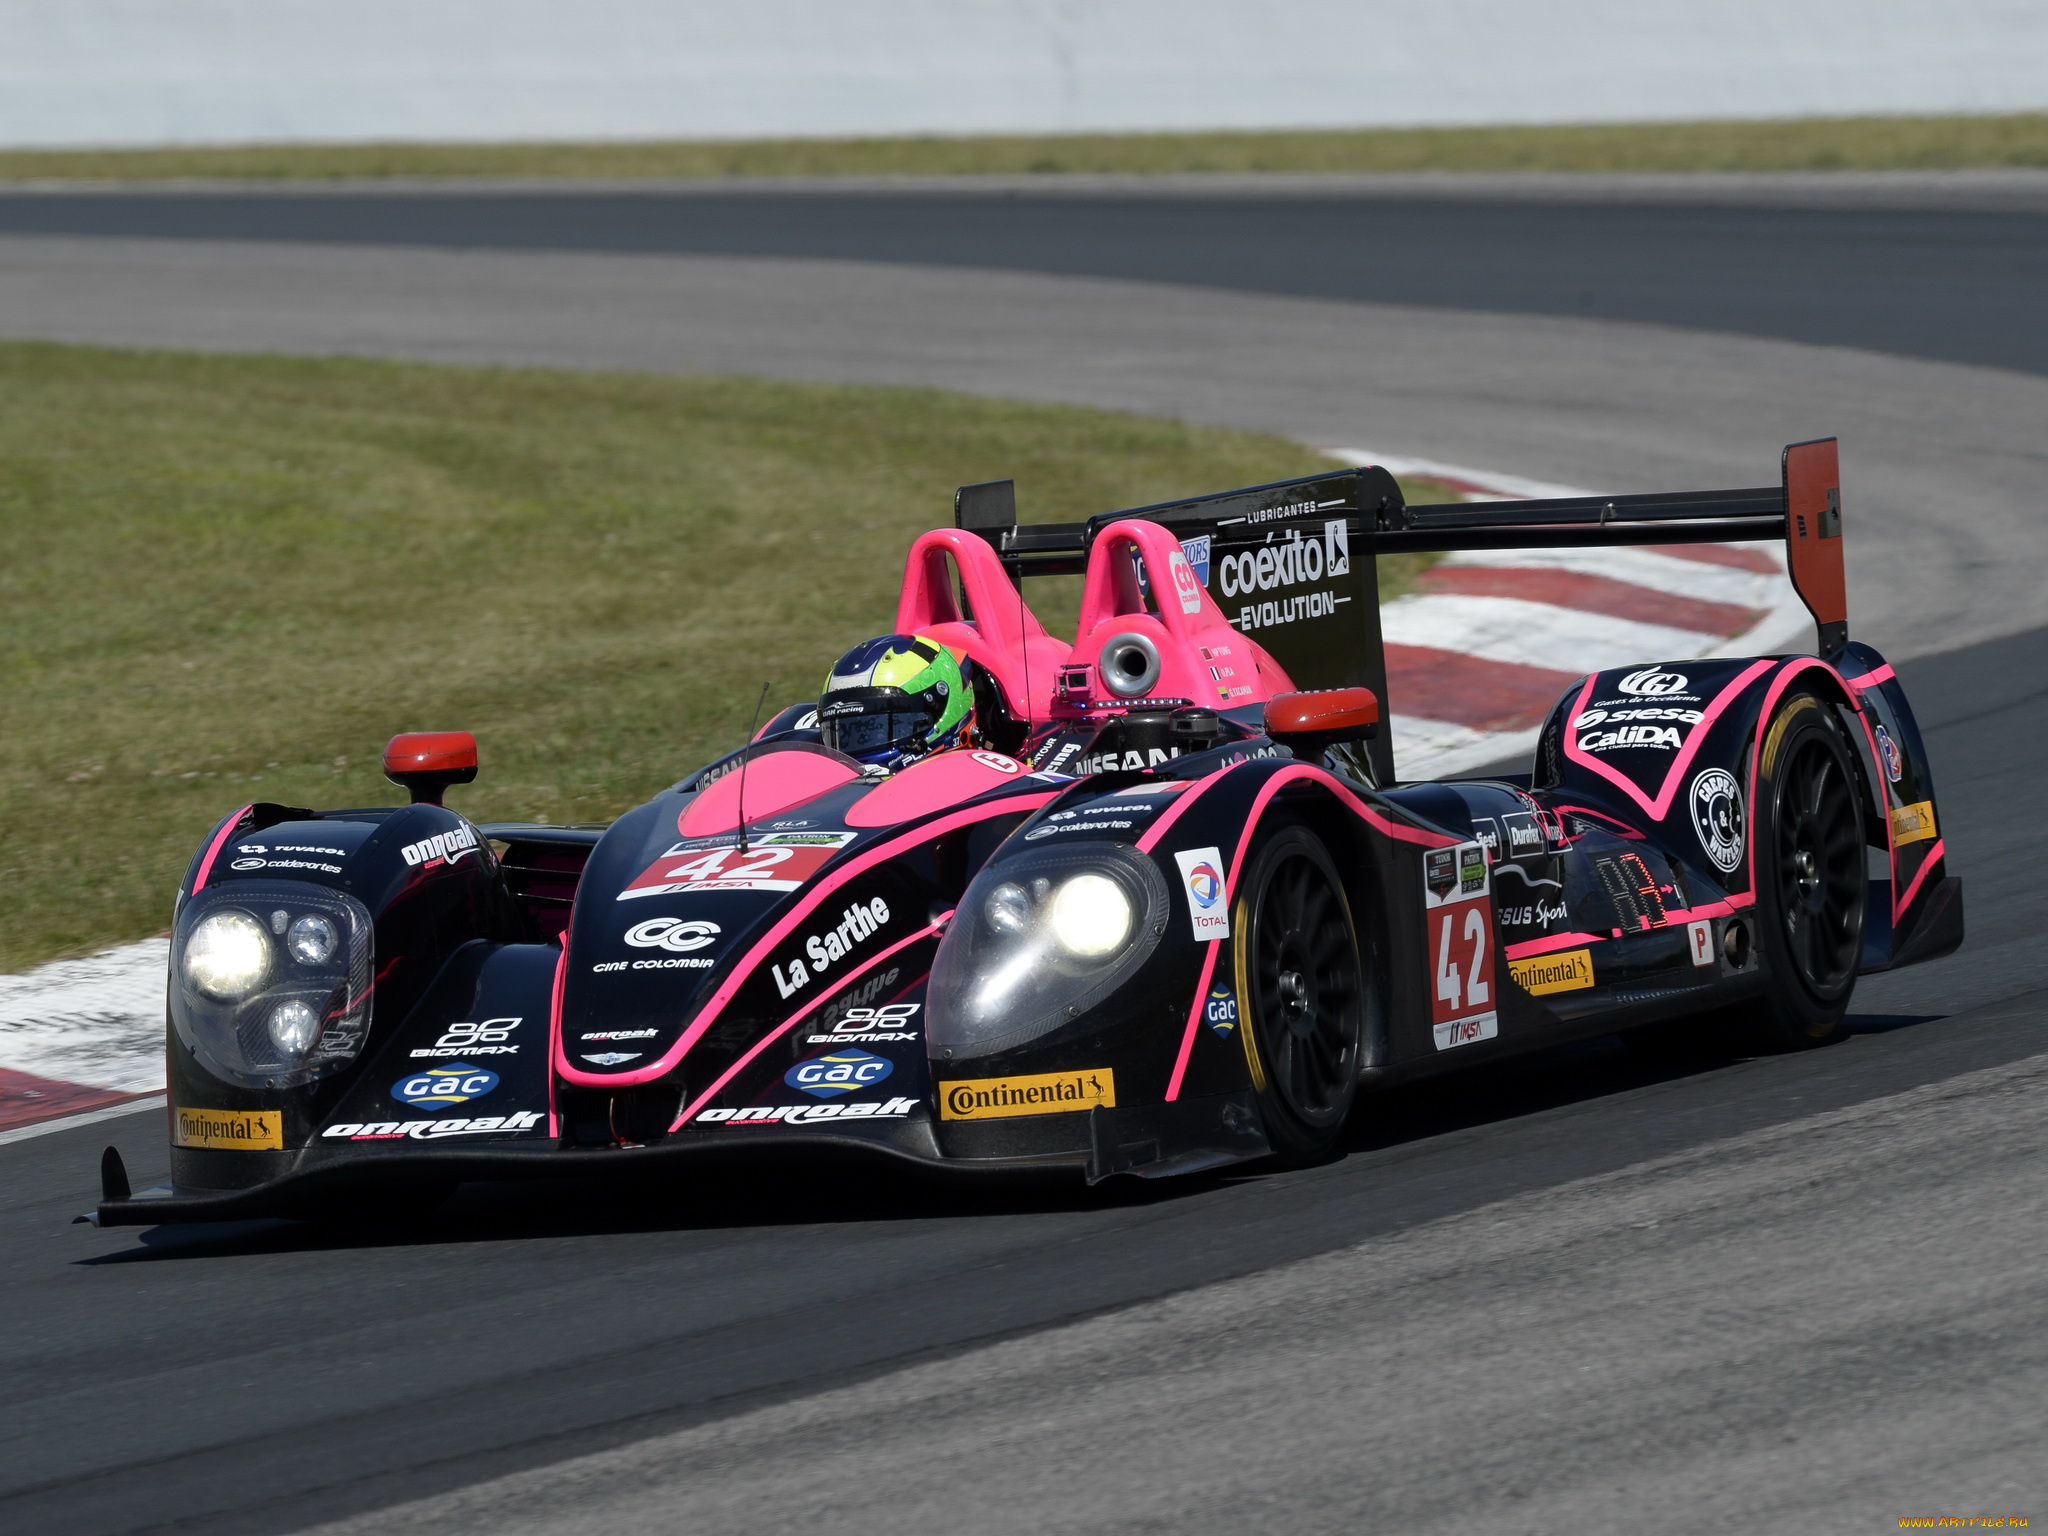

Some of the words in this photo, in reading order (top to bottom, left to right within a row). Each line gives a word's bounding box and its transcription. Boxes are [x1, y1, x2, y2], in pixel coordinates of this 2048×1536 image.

[1247, 501, 1316, 524] LUBRICANTES
[1220, 529, 1324, 597] coéxito
[1240, 591, 1335, 631] EVOLUTION
[836, 706, 864, 716] racing
[1594, 698, 1628, 707] Gases
[1605, 708, 1705, 725] siesa
[1698, 776, 1735, 803] CREPES
[1059, 820, 1132, 833] coldeportes
[274, 845, 346, 856] TUVACOL
[1709, 833, 1741, 864] WAFFLES
[267, 859, 342, 874] coldeportes
[664, 848, 794, 881] 42
[1194, 916, 1227, 927] TOTAL
[1536, 899, 1568, 929] Sport
[771, 959, 810, 1000] La
[806, 897, 890, 972] Sarthe
[1695, 928, 1706, 958] P
[593, 961, 628, 973] CINE
[632, 958, 715, 969] COLOMBIA
[1437, 908, 1489, 1011] 42
[807, 1032, 919, 1043] BIOMAX
[409, 1045, 520, 1058] BIOMAX
[948, 1078, 1085, 1115] Continental
[180, 1113, 253, 1142] Continental
